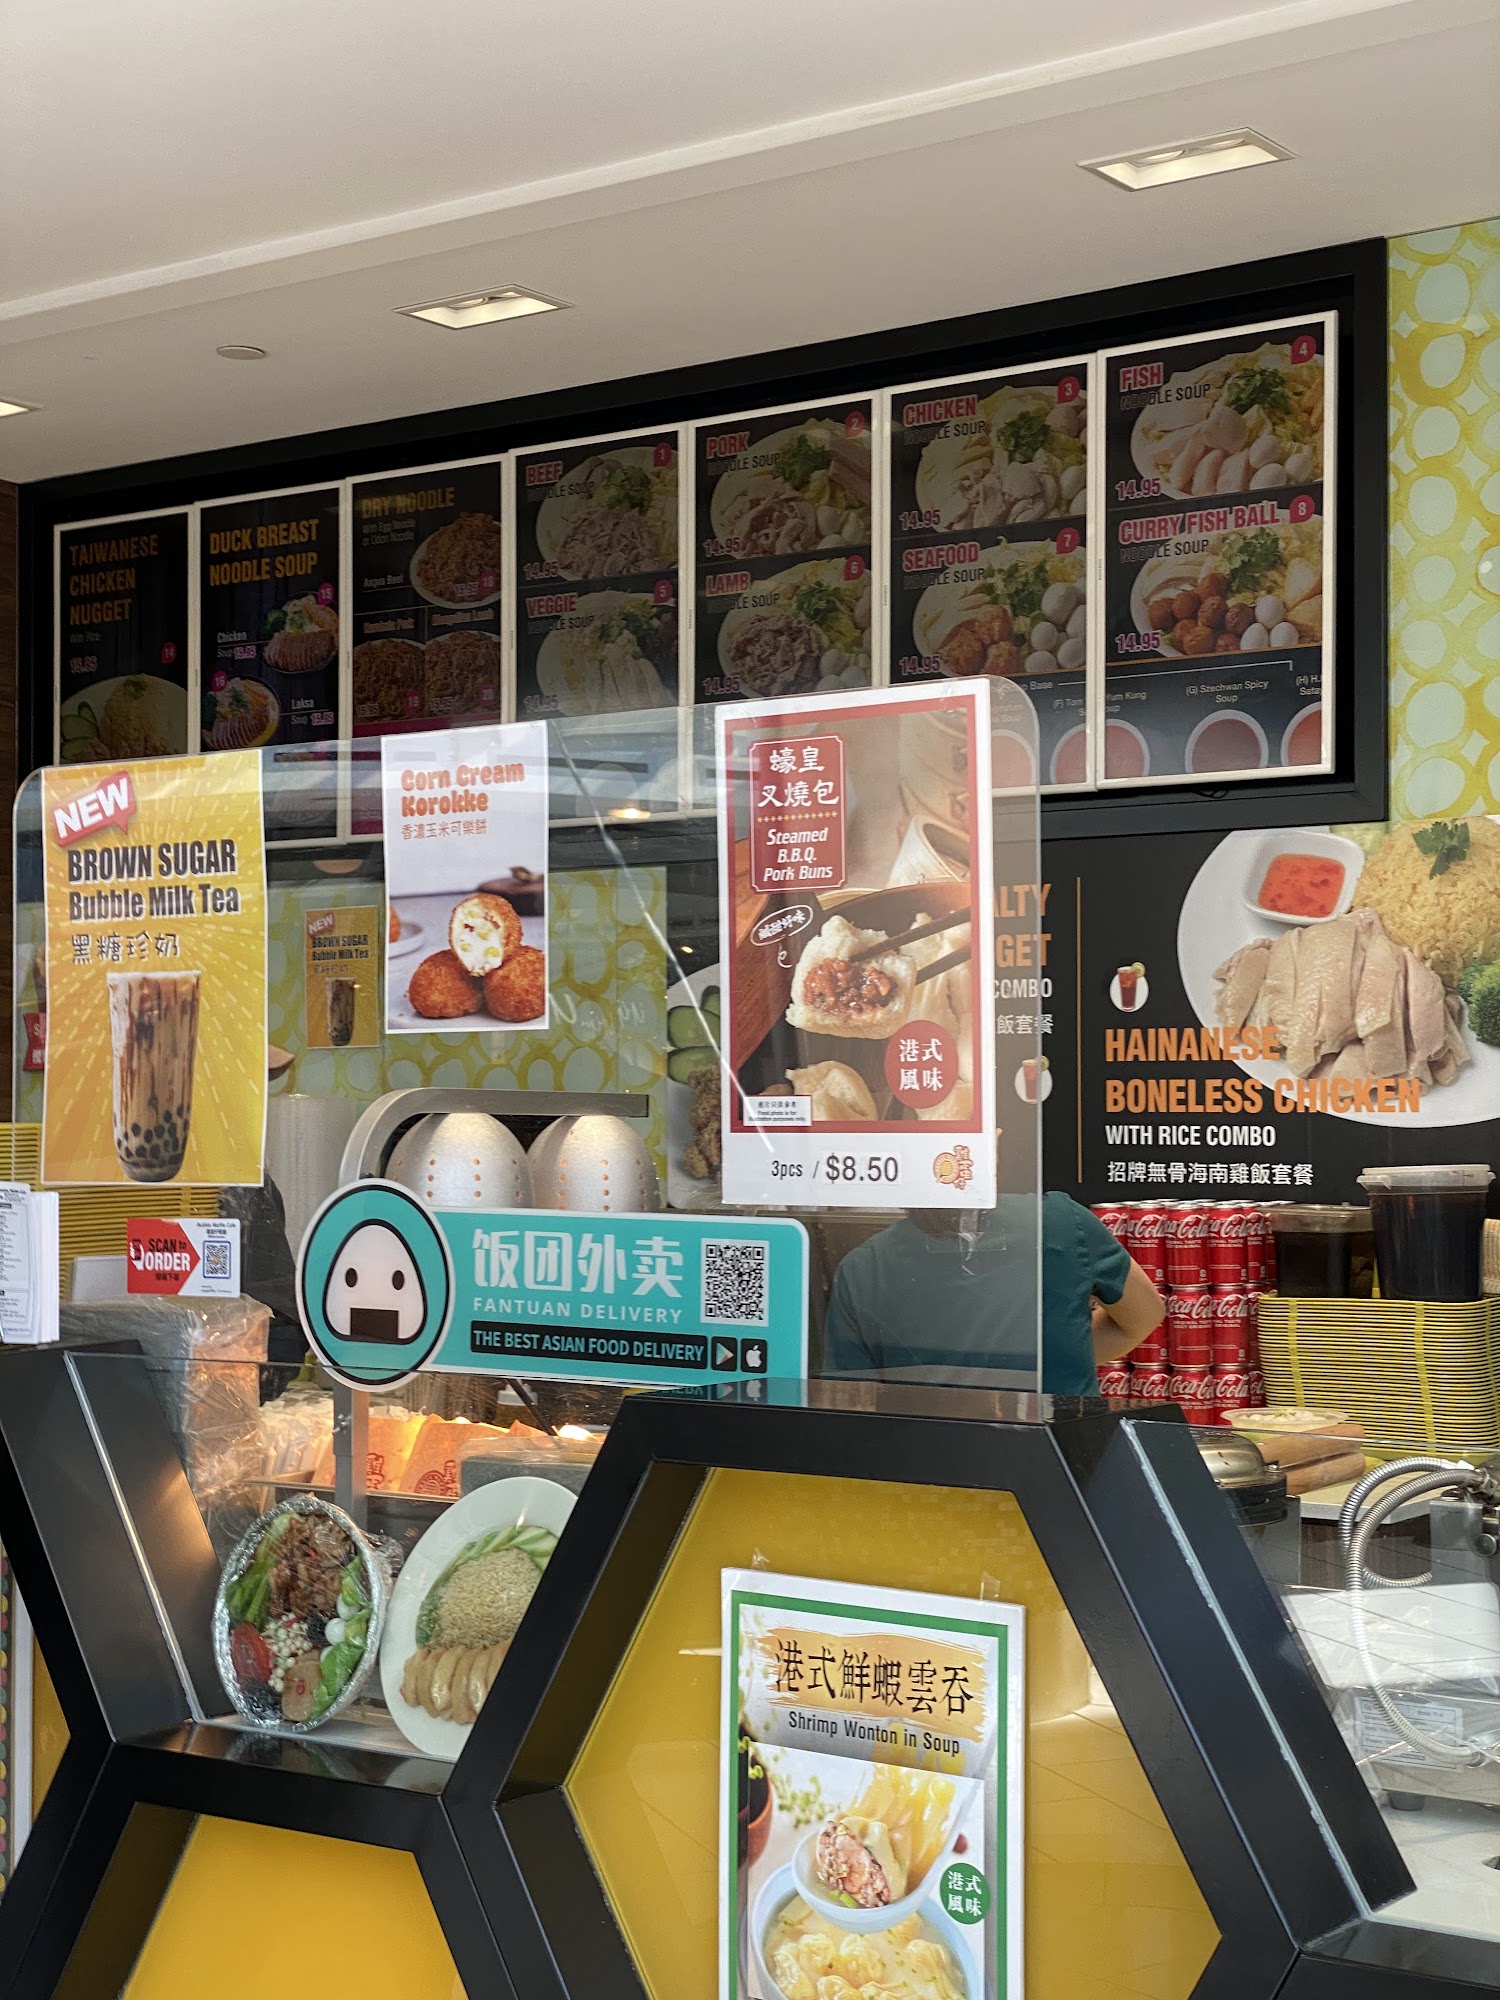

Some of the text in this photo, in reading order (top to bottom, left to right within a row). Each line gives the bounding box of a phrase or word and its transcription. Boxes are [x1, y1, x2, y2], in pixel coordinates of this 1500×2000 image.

[1299, 342, 1308, 355] 4
[1119, 362, 1164, 392] FISH
[1065, 384, 1073, 396] 3
[1176, 383, 1211, 403] SOUP
[903, 395, 977, 427] CHICKEN
[954, 420, 986, 438] SOUP
[706, 432, 750, 459] PORK
[752, 452, 781, 468] SOUP
[527, 461, 563, 487] BEEF
[393, 486, 456, 514] NOODLE
[1115, 477, 1161, 500] 14.95
[899, 510, 940, 529] 14.95
[1119, 500, 1280, 544] CURRY FISH BALL
[1298, 503, 1307, 516] 8
[209, 519, 320, 554] DUCK BREAST
[703, 538, 740, 555] 14.95
[1174, 539, 1209, 556] SOUP
[69, 534, 159, 567] TAIWANESE
[903, 542, 979, 571] SEAFOOD
[209, 551, 319, 586] NOODLE SOUP
[953, 567, 986, 583] SOUP
[69, 567, 136, 597] CHICKEN
[705, 572, 750, 596] LAMB
[69, 598, 132, 625] NUGGET
[527, 593, 578, 618] VEGGIE
[752, 593, 780, 609] SOUP
[1115, 631, 1161, 653] 14.95
[899, 656, 940, 675] 14.95
[703, 677, 740, 694] 14.95
[1030, 680, 1053, 690] Base
[1186, 679, 1269, 696] (G) Szechwan Spicy
[1295, 675, 1309, 687] (H)
[291, 697, 315, 710] Laksa
[1215, 692, 1238, 703] Soup
[769, 745, 825, 774] 蠔皇
[401, 763, 525, 791] Corn Cream
[401, 789, 489, 817] Korokke
[757, 778, 840, 808] 叉燒包
[54, 778, 130, 838] NEW
[766, 827, 828, 846] Steamed
[67, 839, 237, 882] BROWN SUGAR
[777, 845, 817, 864] B.B.Q.
[763, 862, 833, 882] Pork Buns
[69, 883, 240, 921] Bubble Milk Tea
[309, 913, 334, 935] NEW
[70, 931, 181, 964] 黑糖珍奶
[312, 934, 368, 948] BROWN SUGAR
[312, 950, 337, 961] Bubble
[354, 948, 369, 959] Tea
[899, 1038, 943, 1063] 港式
[1105, 1026, 1281, 1062] HAINANESE
[899, 1066, 943, 1092] 風味
[1105, 1077, 1421, 1114] BONELESS CHICKEN
[1105, 1126, 1277, 1147] WITH RICE COMBO
[771, 1160, 803, 1180] 3pcs
[826, 1154, 898, 1185] $8.50
[1107, 1162, 1314, 1187] 招牌無骨海南雞飯套餐
[149, 1238, 177, 1252] SCAN
[145, 1252, 191, 1272] ORDER
[472, 1228, 684, 1298] 饭团外卖
[472, 1297, 684, 1325] FANTUAN DELIVERY
[473, 1328, 704, 1362] THE BEST ASIAN FOOD DELIVERY
[774, 1639, 974, 1718] 港式鮮蝦雲吞
[788, 1711, 960, 1758] Shrimp Wonton in Soup
[948, 1870, 981, 1894] 港式
[948, 1892, 983, 1918] 風味
